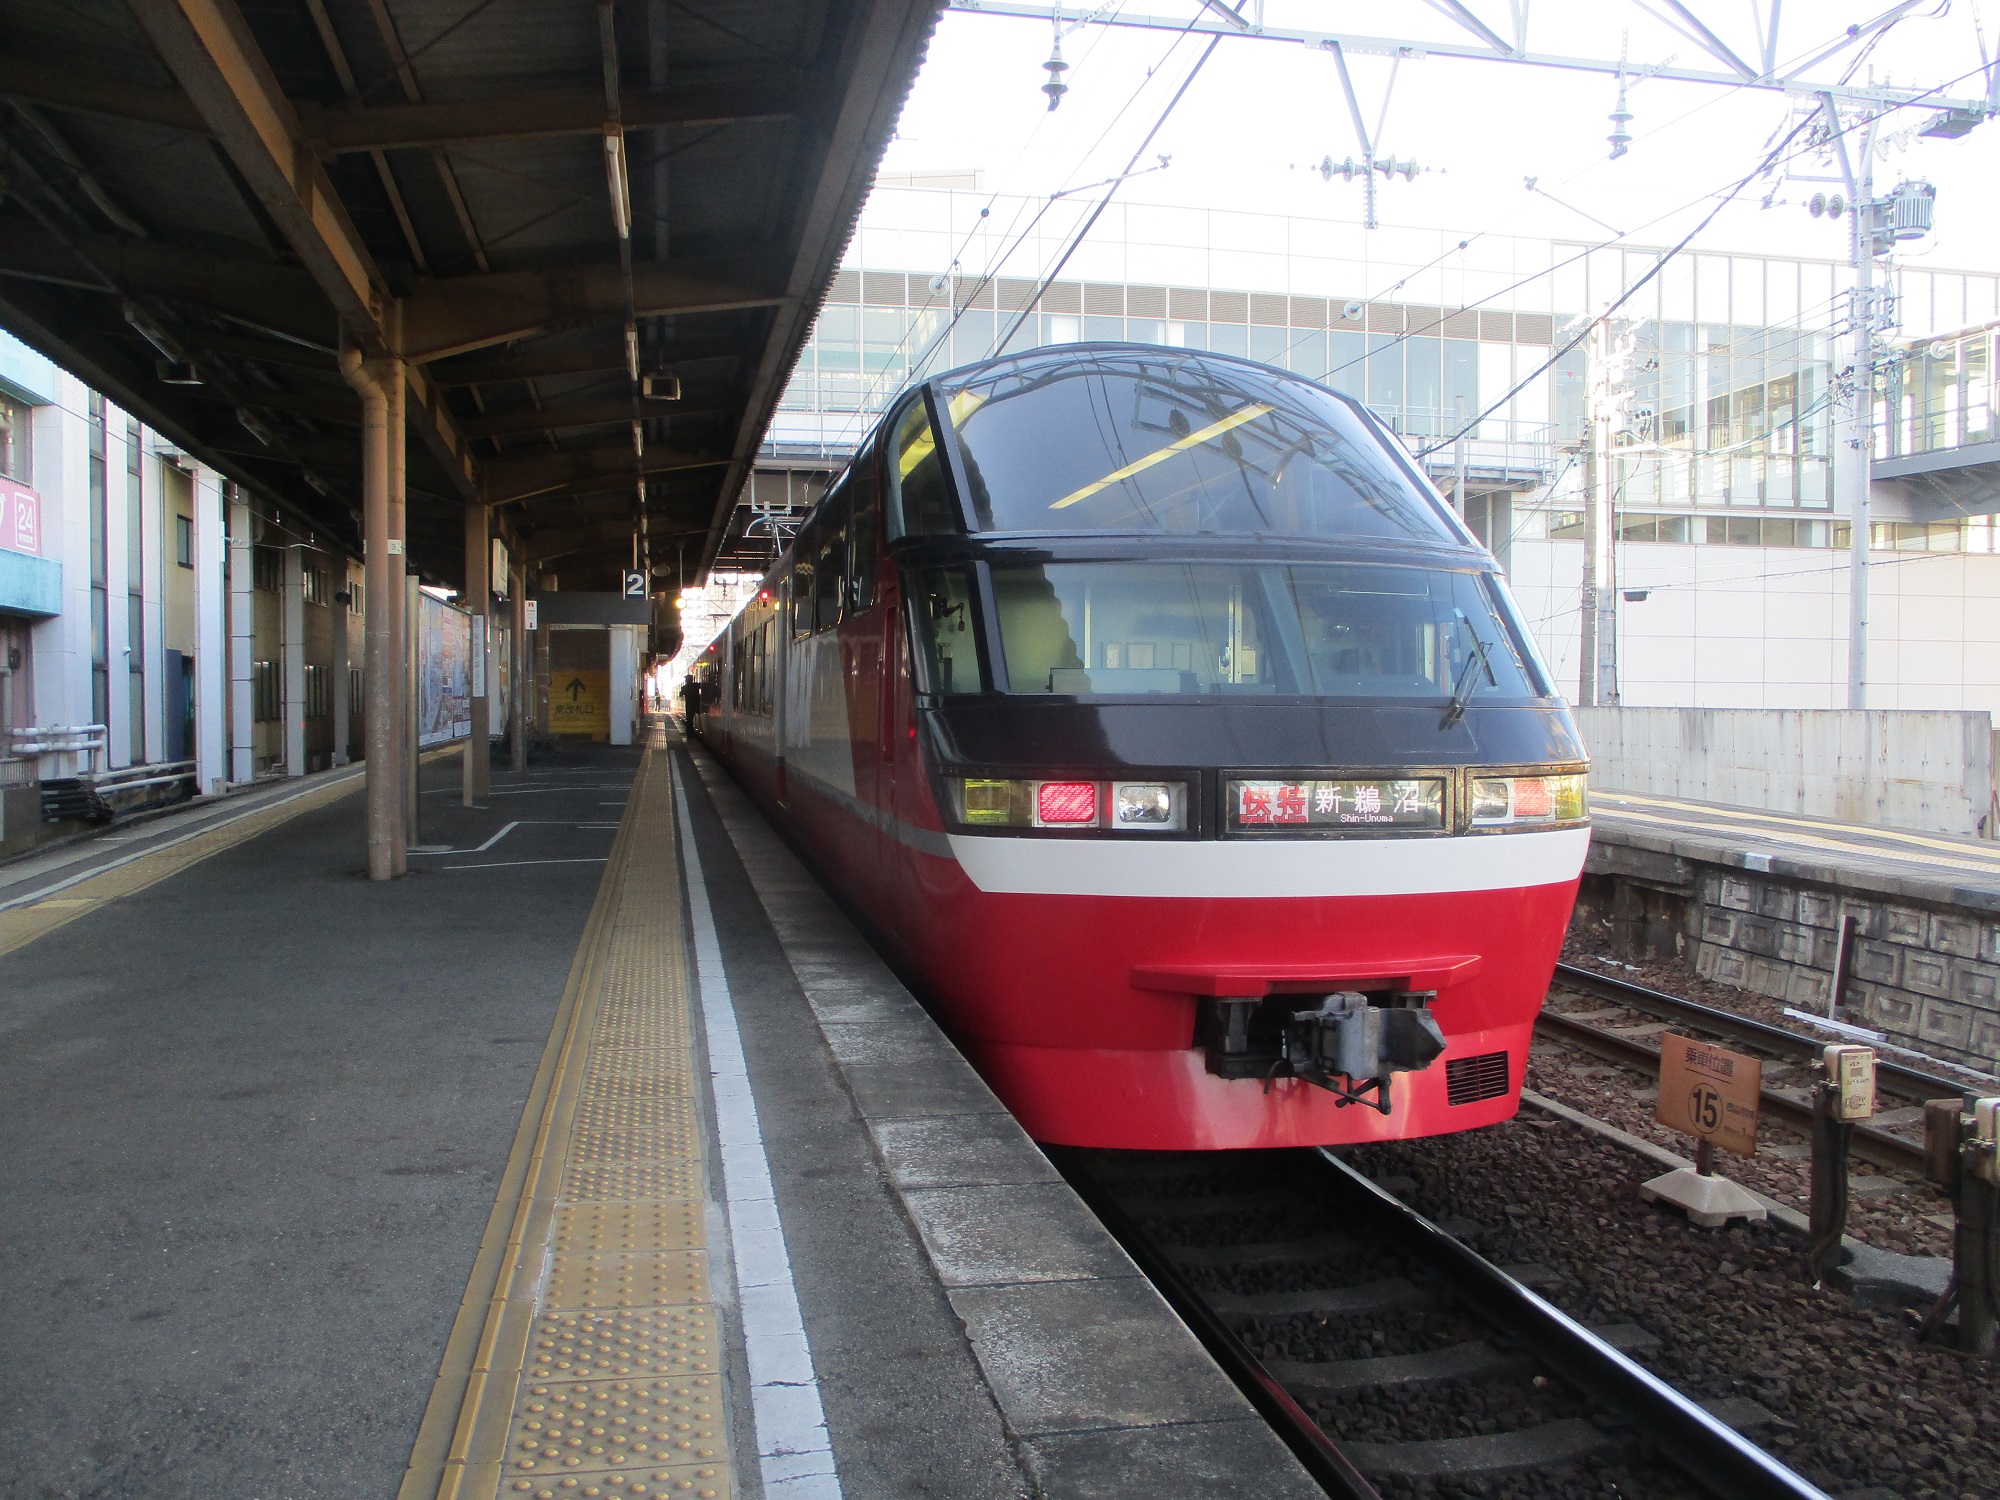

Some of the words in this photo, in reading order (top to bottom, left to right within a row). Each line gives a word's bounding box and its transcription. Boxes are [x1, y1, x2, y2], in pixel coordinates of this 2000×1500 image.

[18, 502, 33, 534] 24
[627, 573, 644, 595] 2
[1243, 785, 1306, 815] 快特
[1315, 785, 1420, 814] 新鵜沼
[1340, 813, 1394, 823] Shin-Unuma
[1685, 1047, 1734, 1077] 乗車位置
[1692, 1088, 1718, 1128] 15
